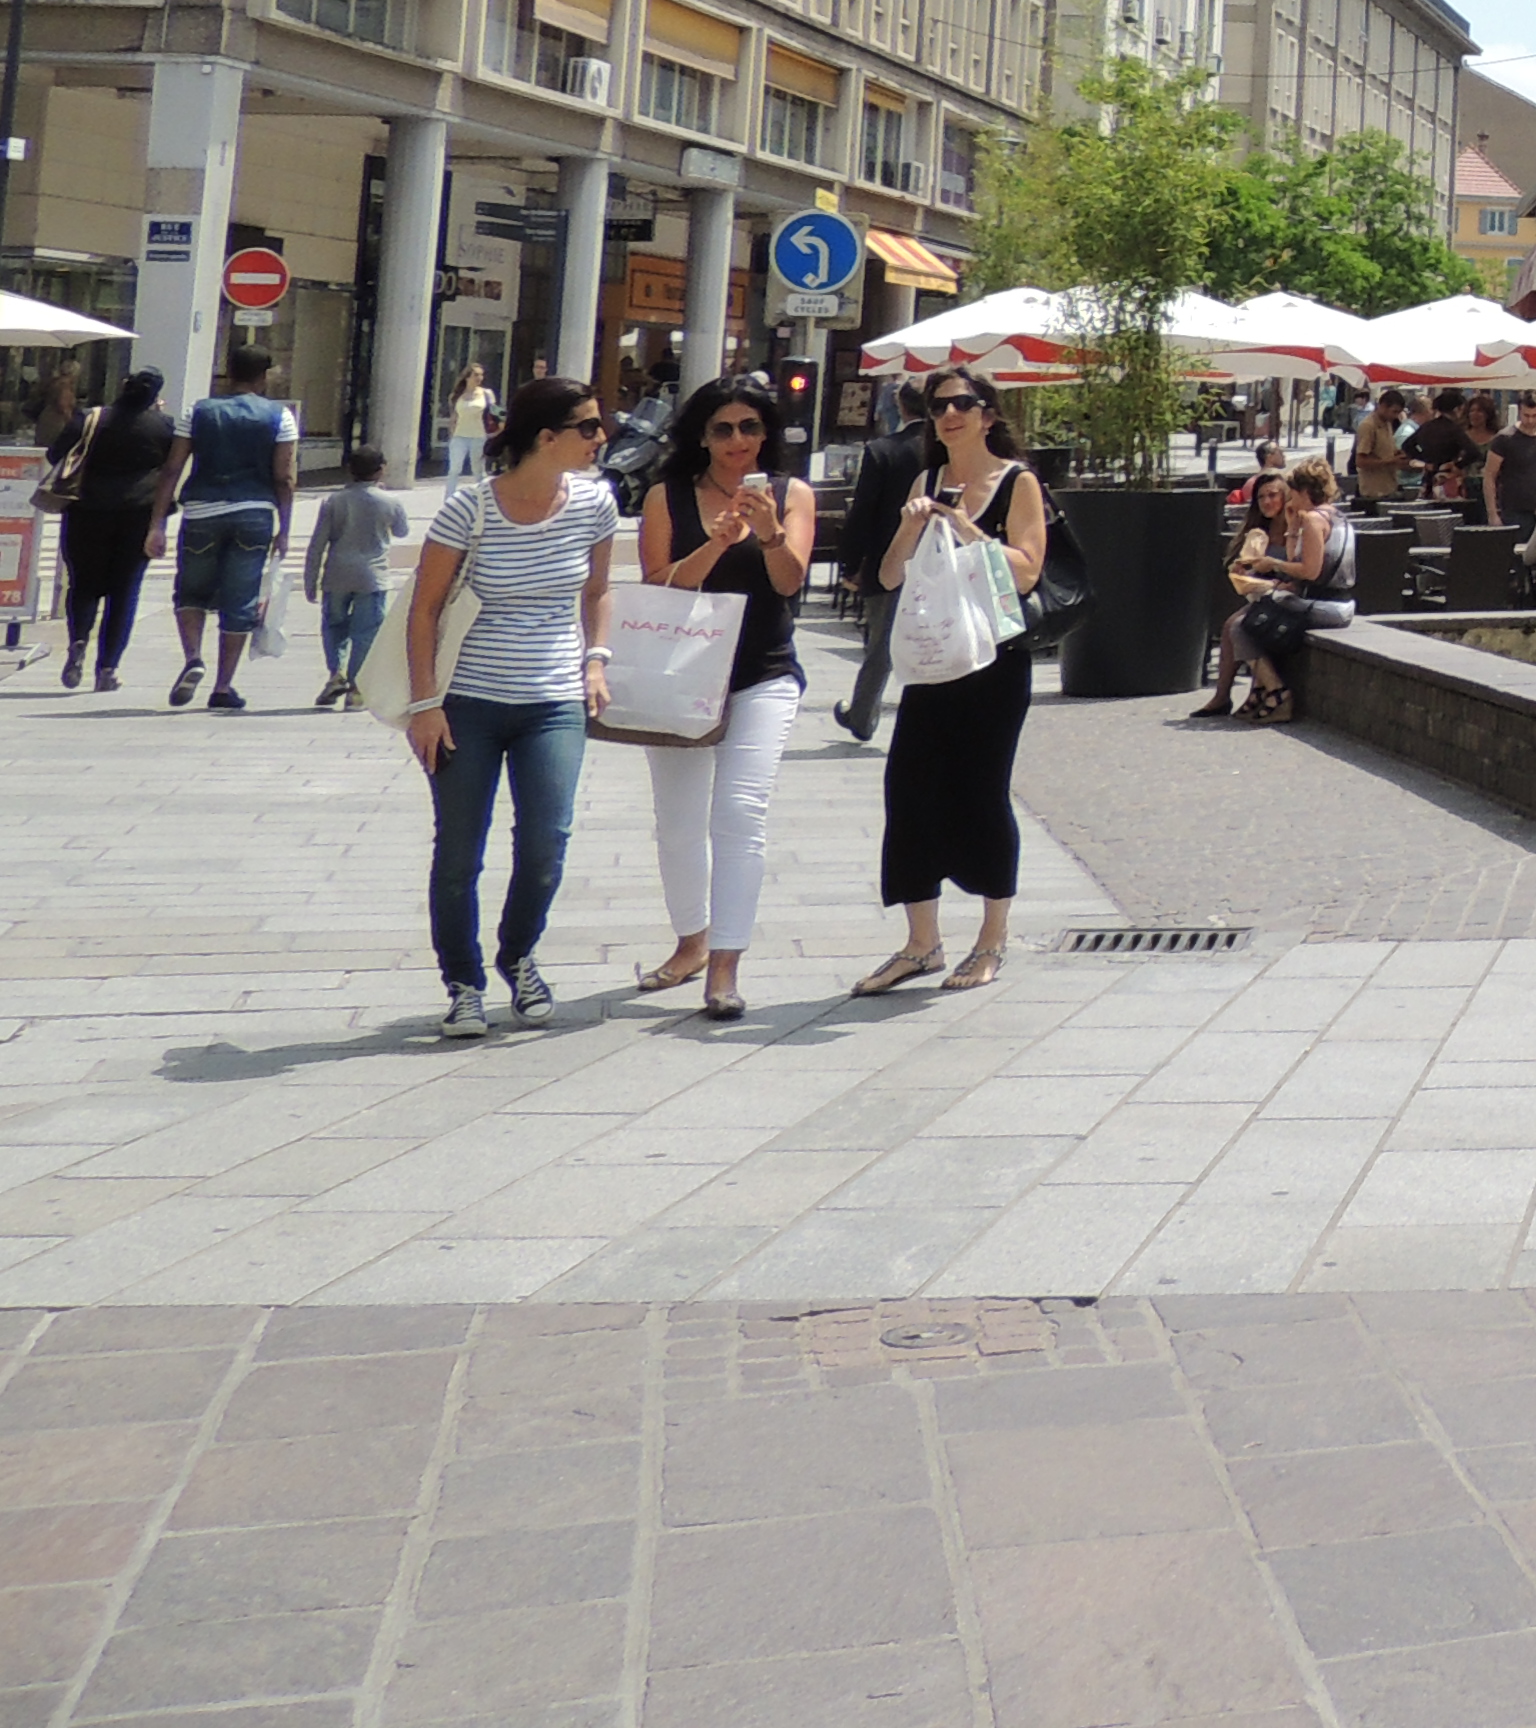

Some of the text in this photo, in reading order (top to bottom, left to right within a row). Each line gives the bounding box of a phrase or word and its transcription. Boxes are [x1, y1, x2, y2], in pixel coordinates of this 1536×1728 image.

[800, 296, 826, 305] SAUF
[793, 305, 830, 314] CYCLES
[621, 619, 670, 632] NAF
[674, 625, 725, 640] NAF
